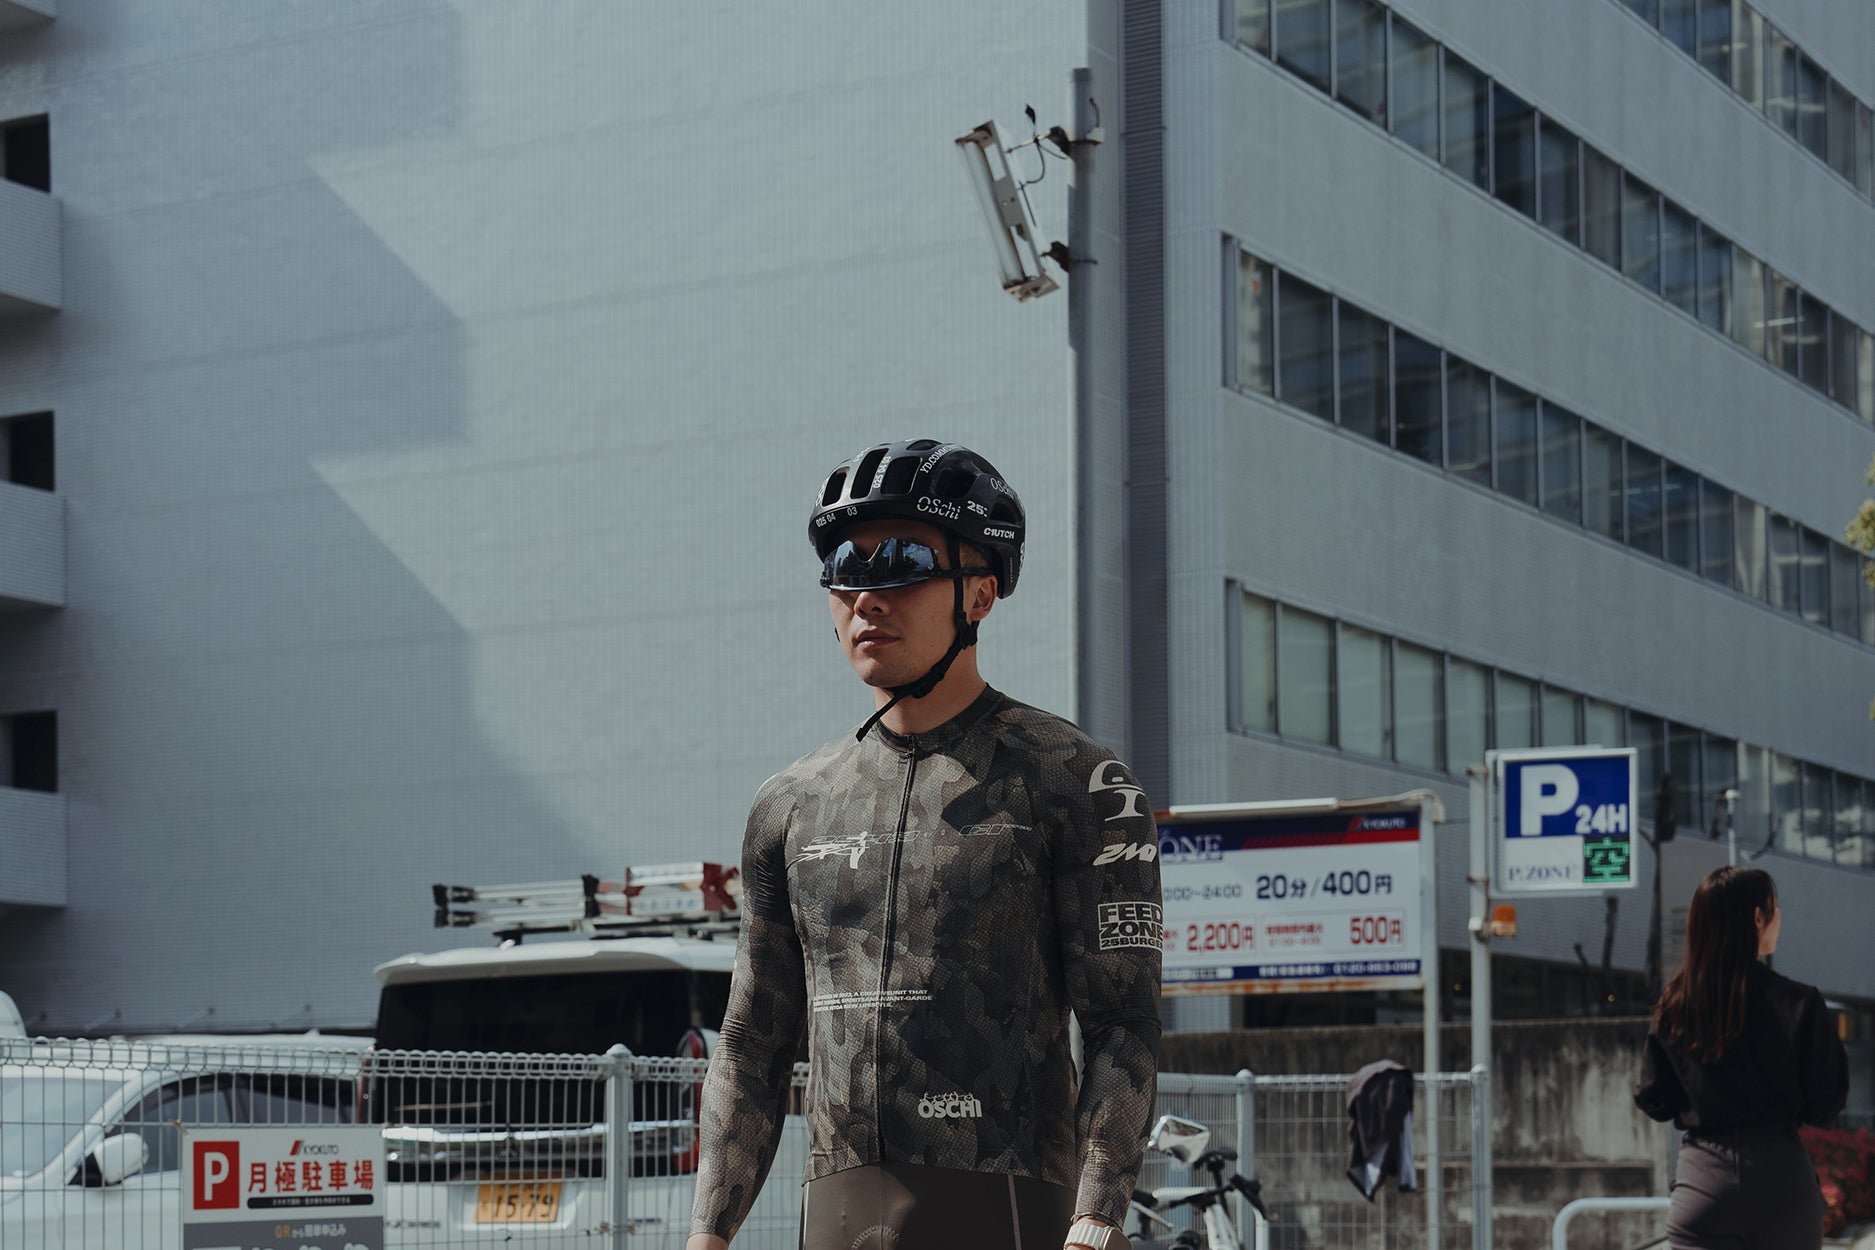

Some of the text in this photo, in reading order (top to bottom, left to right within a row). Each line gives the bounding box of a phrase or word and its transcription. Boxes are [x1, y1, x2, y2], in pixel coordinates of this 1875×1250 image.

[846, 506, 858, 517] 03
[1520, 764, 1580, 837] P
[1575, 803, 1628, 834] 24H
[1584, 837, 1631, 883] 空
[1099, 903, 1163, 923] FEED
[1100, 921, 1163, 939] ZONE
[1350, 916, 1402, 945] 500円
[917, 1097, 983, 1119] OSCHI
[203, 1151, 230, 1201] P
[248, 1160, 374, 1194] 月極駐車場
